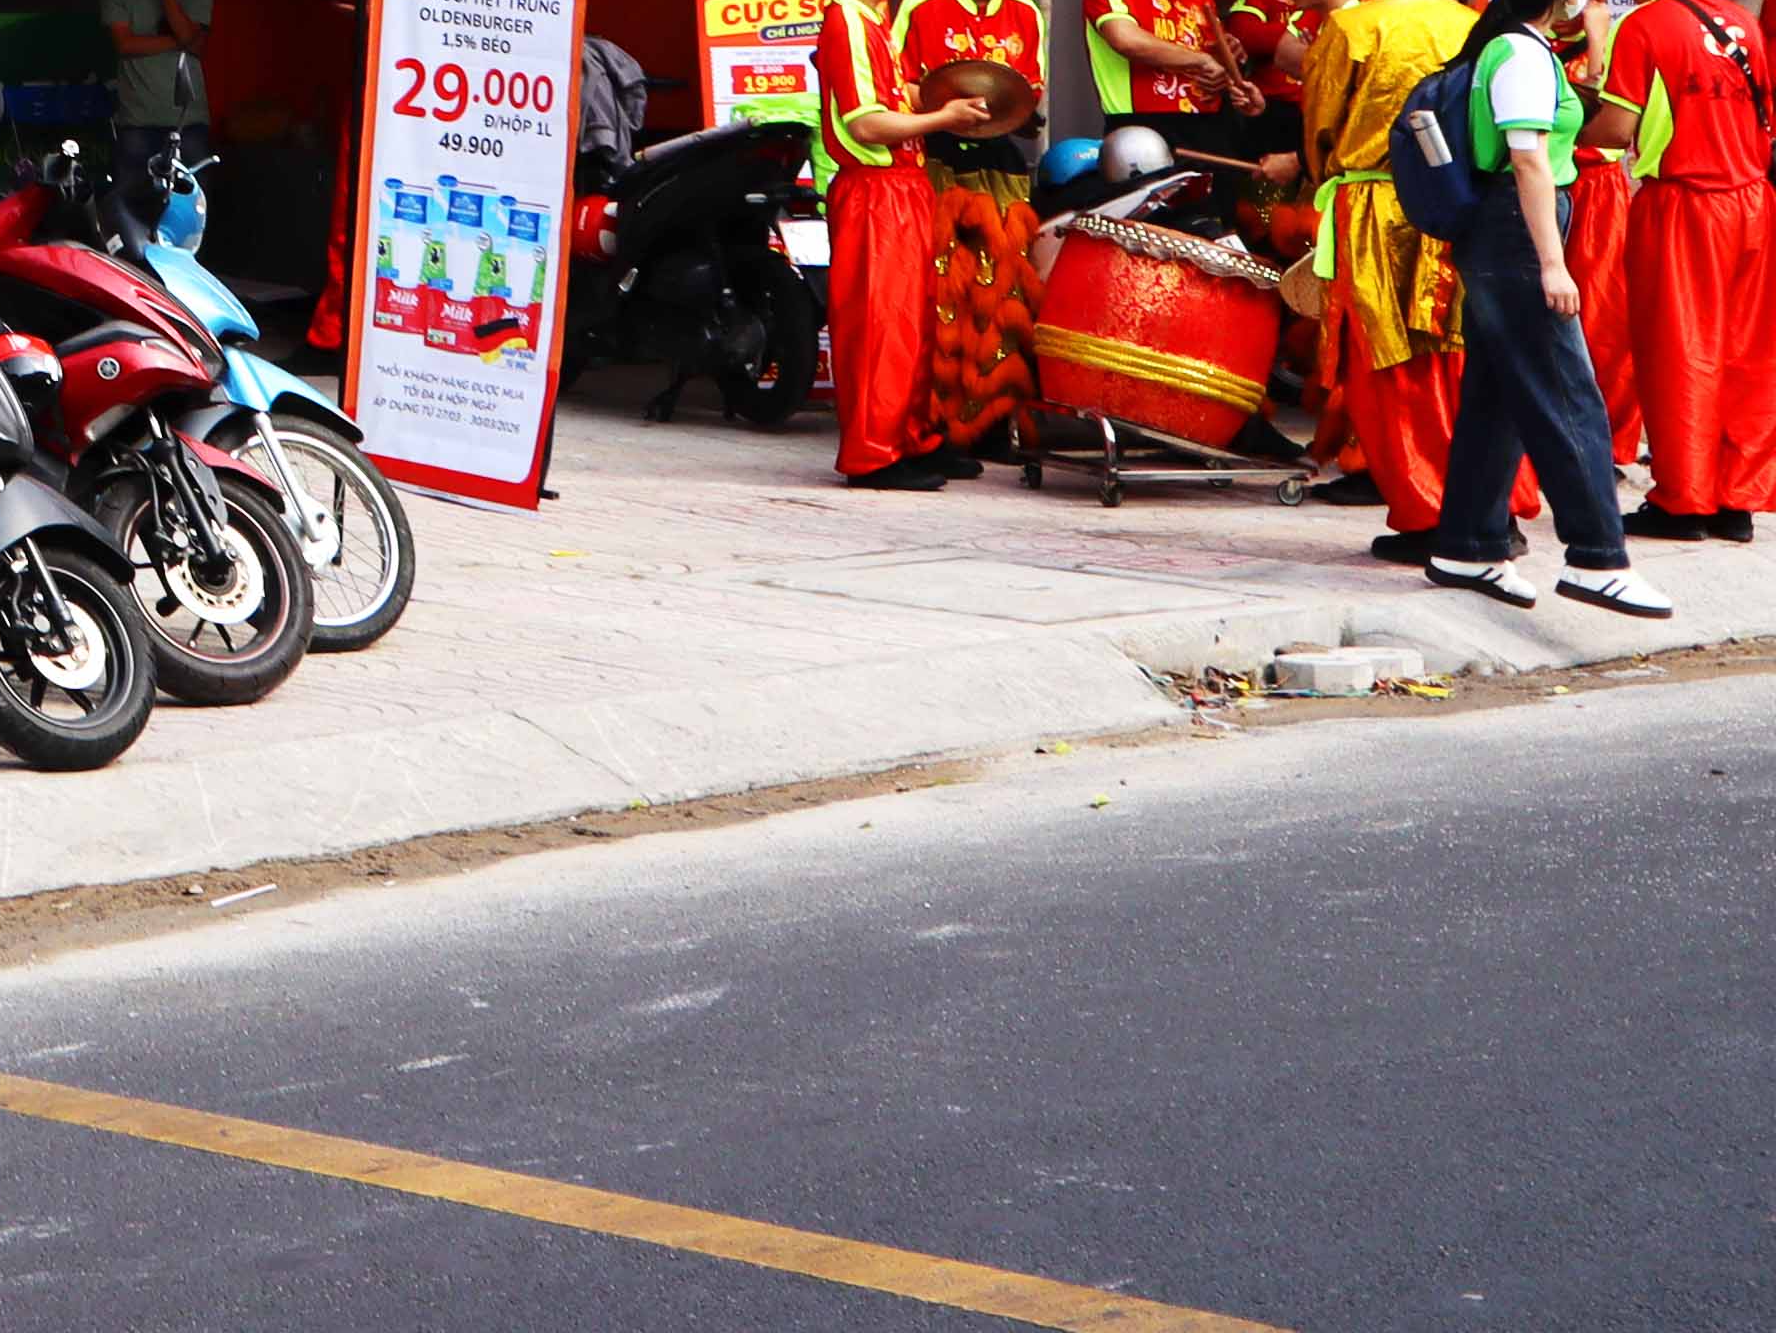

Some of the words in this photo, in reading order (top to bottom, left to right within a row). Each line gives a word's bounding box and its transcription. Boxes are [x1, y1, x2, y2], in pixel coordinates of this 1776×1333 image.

[419, 7, 534, 36] OLDENBURGER
[481, 33, 512, 55] BÉO
[392, 57, 554, 122] 29.000
[744, 73, 796, 93] 19.900
[484, 111, 533, 136] Đ/HỘP
[438, 135, 504, 159] 49.900
[440, 301, 475, 324] Milk
